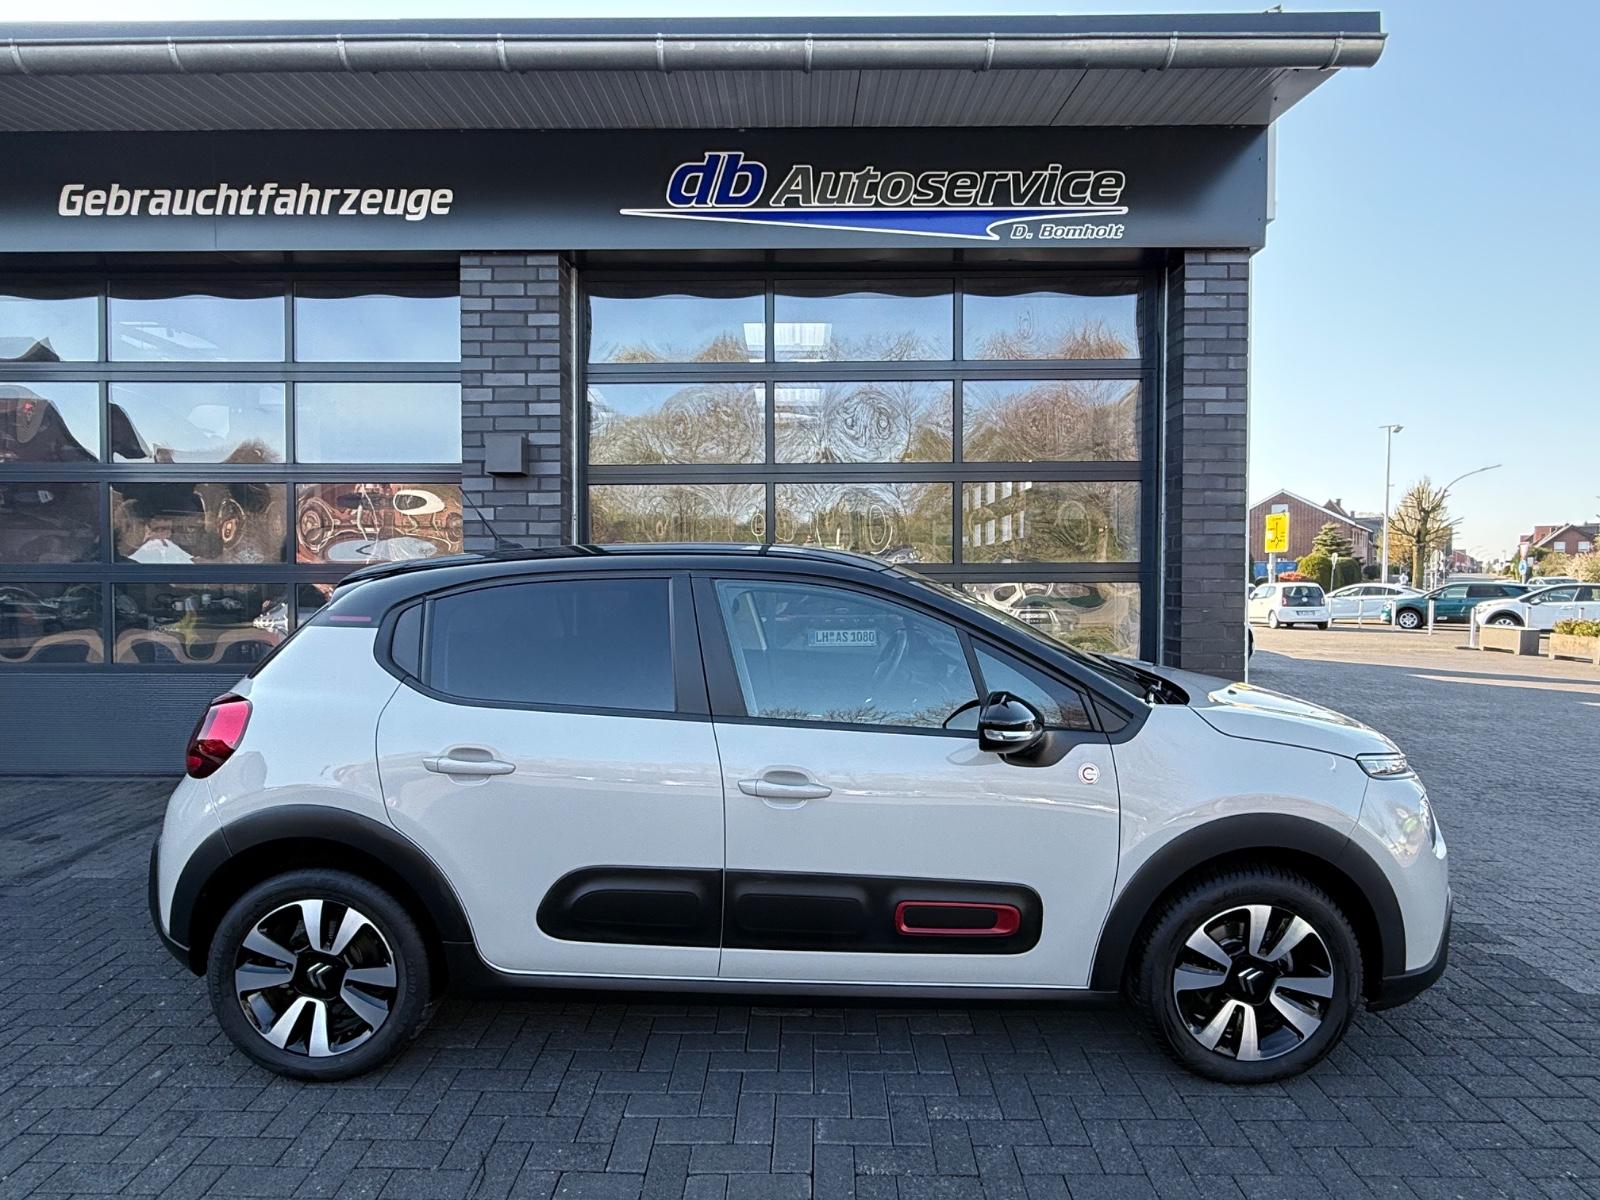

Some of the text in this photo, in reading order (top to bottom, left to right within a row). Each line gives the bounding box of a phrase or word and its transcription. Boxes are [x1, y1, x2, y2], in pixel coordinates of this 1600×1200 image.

[666, 151, 1126, 208] db Autoservice
[57, 182, 454, 221] Gebrauchtfahrzeuge
[1010, 224, 1125, 239] D. Bomholt
[850, 631, 875, 643] 1080
